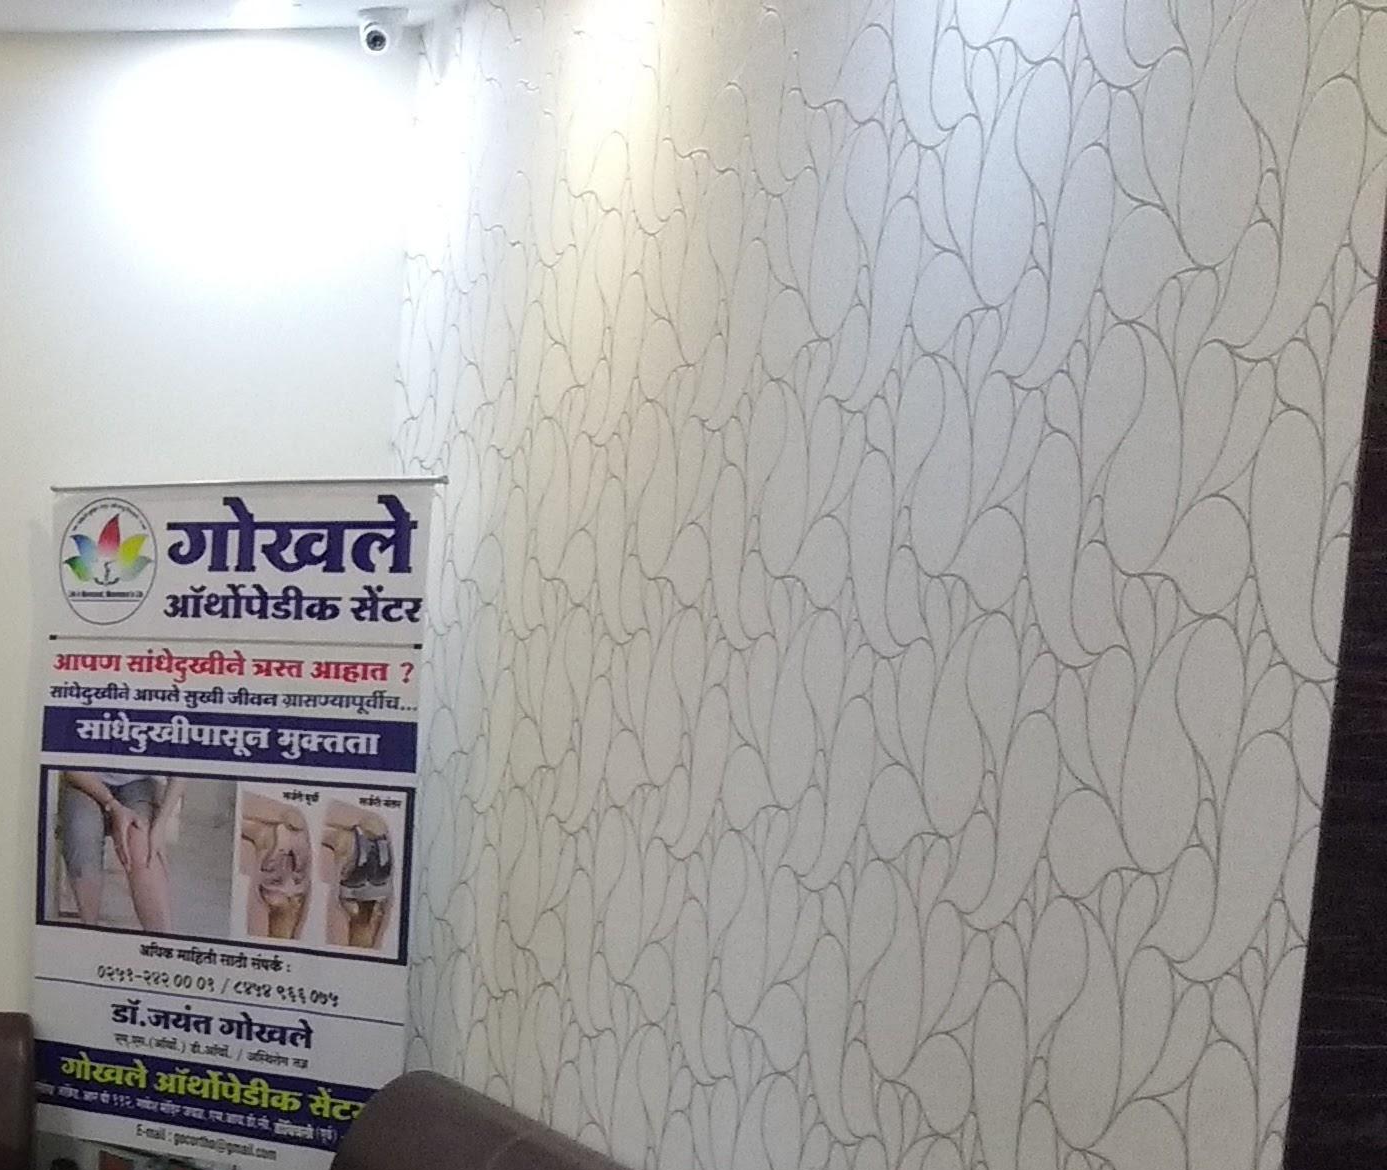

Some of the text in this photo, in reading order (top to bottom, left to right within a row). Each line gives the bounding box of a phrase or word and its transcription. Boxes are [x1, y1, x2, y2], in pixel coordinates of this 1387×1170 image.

[167, 494, 418, 573] गोखले
[163, 583, 423, 622] ऑर्थोपेडीक सेंटर
[53, 649, 415, 684] आपण सांधेदुखीने त्रस्त आहात ?
[50, 684, 129, 706] सांधेदुखीने
[133, 685, 180, 703] आपले
[184, 686, 224, 708] सुखी
[226, 689, 277, 708] जीवन
[76, 712, 380, 760] सांधेदुखीपासून मुक्तता
[139, 942, 173, 958] अधिक
[177, 946, 217, 966] माहिती
[220, 951, 247, 969] साठी
[251, 953, 283, 973] संपर्क
[219, 1011, 314, 1050] गोखले
[60, 1051, 149, 1089] गोखले
[153, 1067, 303, 1114] ऑर्थोपेडीक
